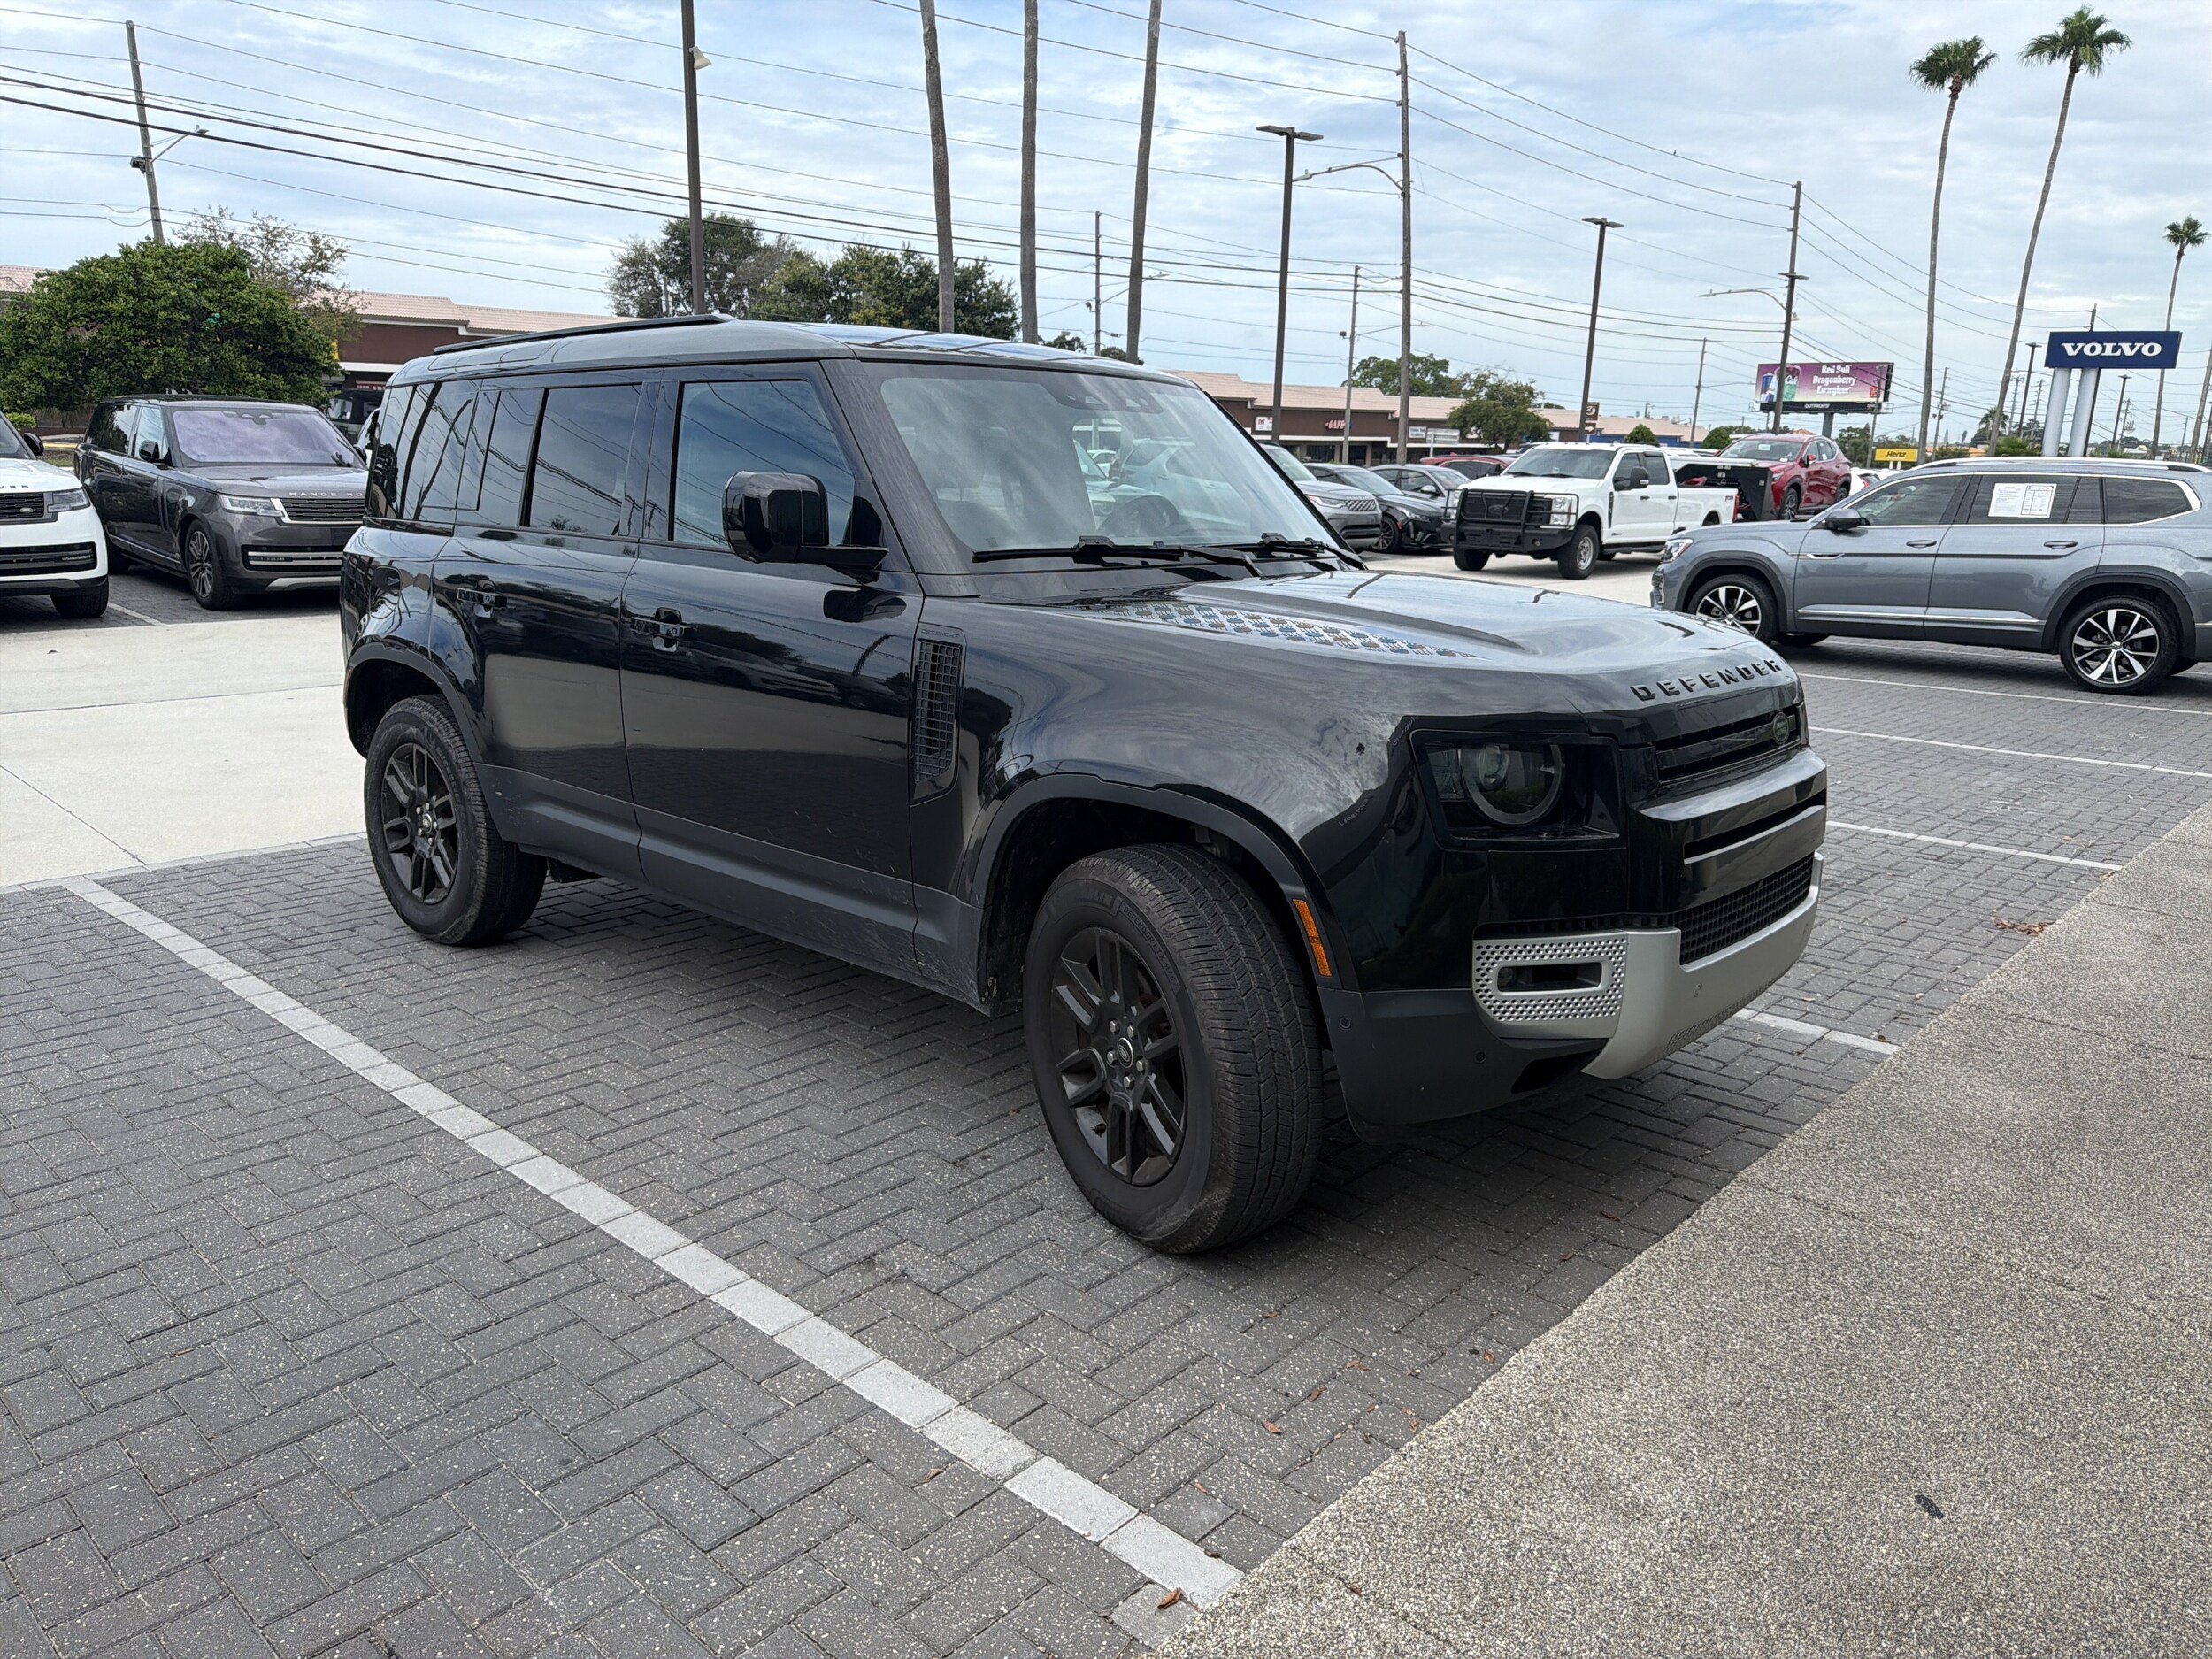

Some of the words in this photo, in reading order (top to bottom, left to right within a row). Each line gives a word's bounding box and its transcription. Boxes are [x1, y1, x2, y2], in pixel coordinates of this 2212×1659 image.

[2061, 342, 2162, 357] VOLVO
[1630, 659, 1782, 702] DEFENDER
[1122, 905, 1155, 944] DEFENDER
